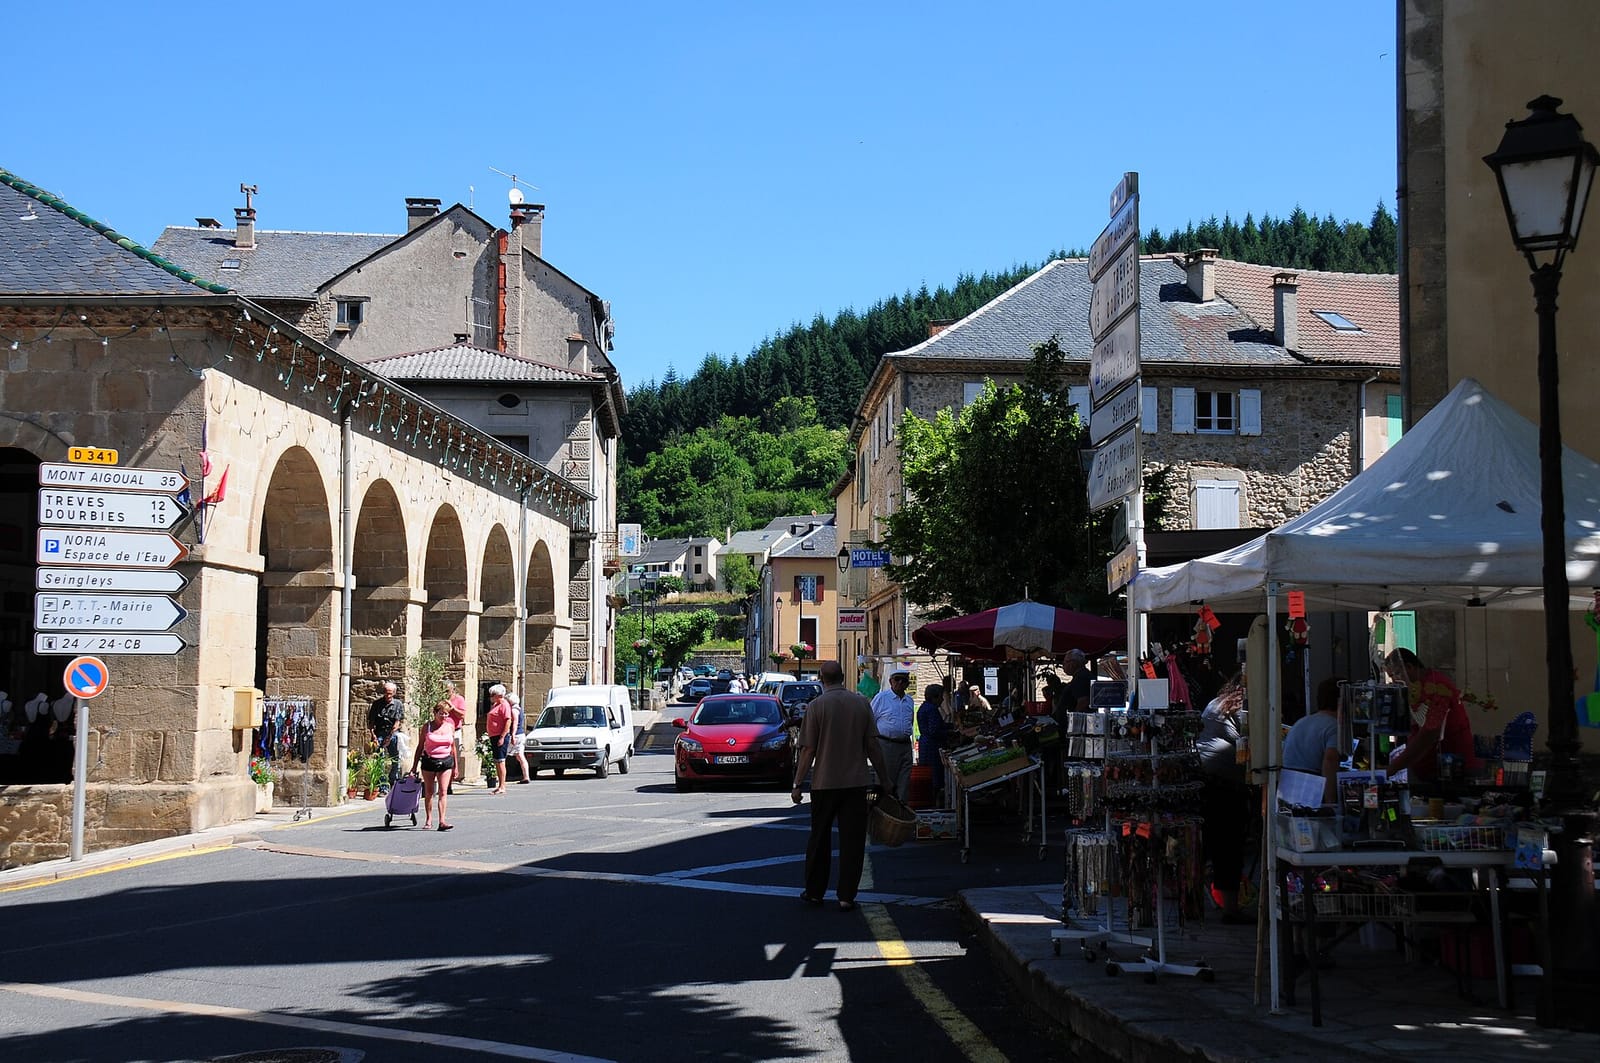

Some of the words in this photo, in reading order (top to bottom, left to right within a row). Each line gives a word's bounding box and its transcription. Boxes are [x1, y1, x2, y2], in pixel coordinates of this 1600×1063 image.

[74, 450, 82, 460] D
[87, 450, 113, 462] 341
[47, 469, 86, 481] MONT
[90, 472, 145, 485] AIGOUAL
[160, 476, 177, 487] 35
[46, 495, 105, 508] TREVES
[151, 500, 166, 511] 12
[45, 508, 125, 522] DOURBIES
[151, 513, 166, 524] 15
[64, 535, 107, 547] NORIA
[64, 549, 110, 563] Espace
[115, 551, 131, 562] de
[136, 551, 167, 563] l'Eau
[852, 551, 883, 561] HOTEL
[44, 573, 114, 588] Seingleys
[61, 638, 80, 649] 24
